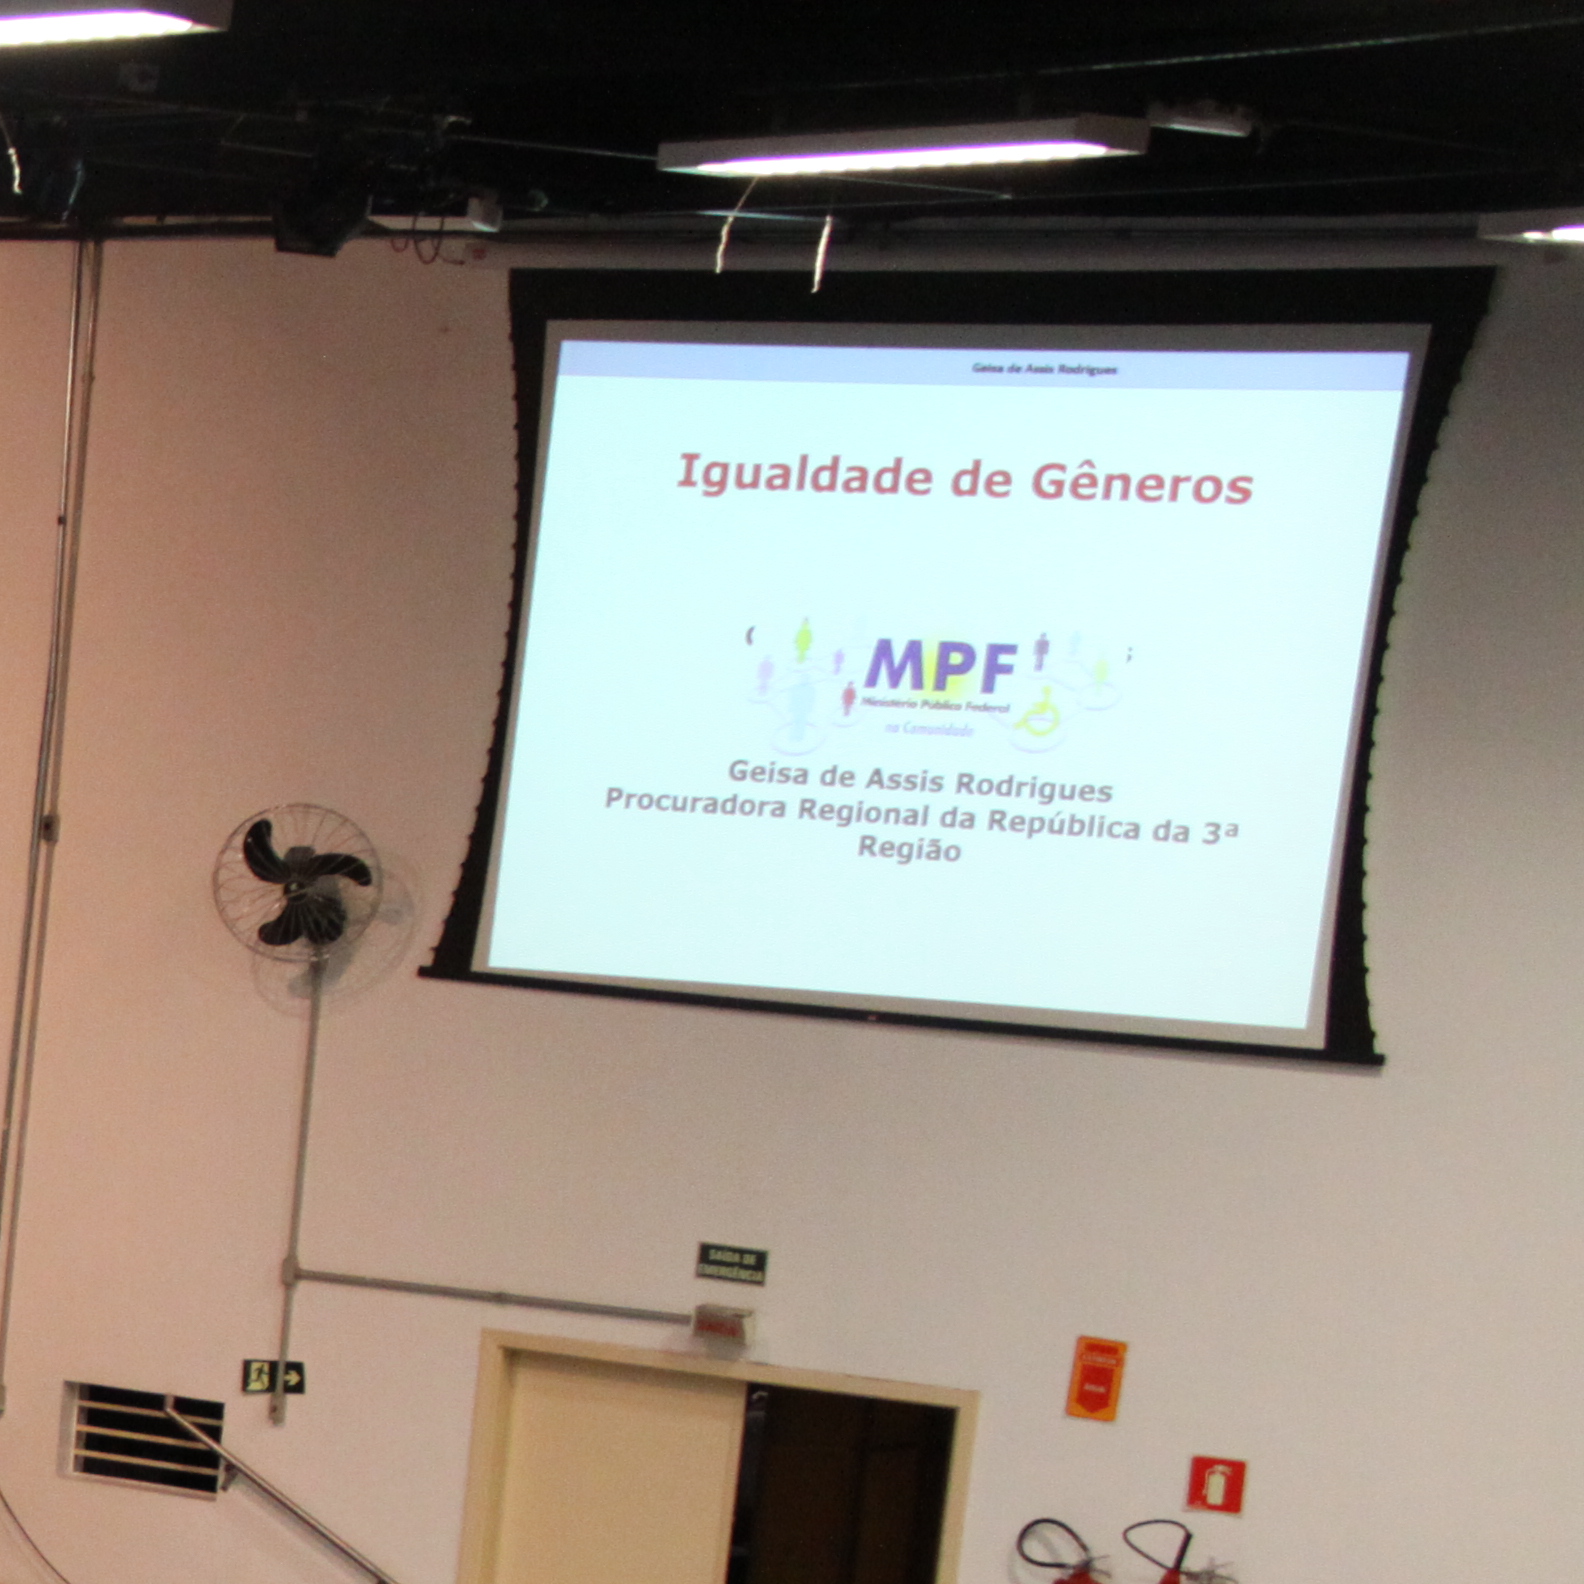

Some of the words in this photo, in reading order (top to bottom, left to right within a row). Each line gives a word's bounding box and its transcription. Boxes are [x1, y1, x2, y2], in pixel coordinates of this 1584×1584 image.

[677, 452, 933, 498] Igualdade
[951, 459, 1013, 499] de
[1032, 459, 1254, 505] Gêneros
[863, 638, 1018, 695] MPF
[728, 759, 809, 786] Geisa
[819, 764, 856, 788] de
[865, 767, 944, 793] Assis
[955, 772, 1113, 806] Rodrigues
[605, 787, 787, 819] Procuradora
[798, 798, 930, 828] Regional
[939, 806, 976, 830] da
[987, 809, 1141, 841] República
[1152, 819, 1190, 844] da
[1201, 821, 1239, 846] 3ª
[857, 834, 962, 866] Região
